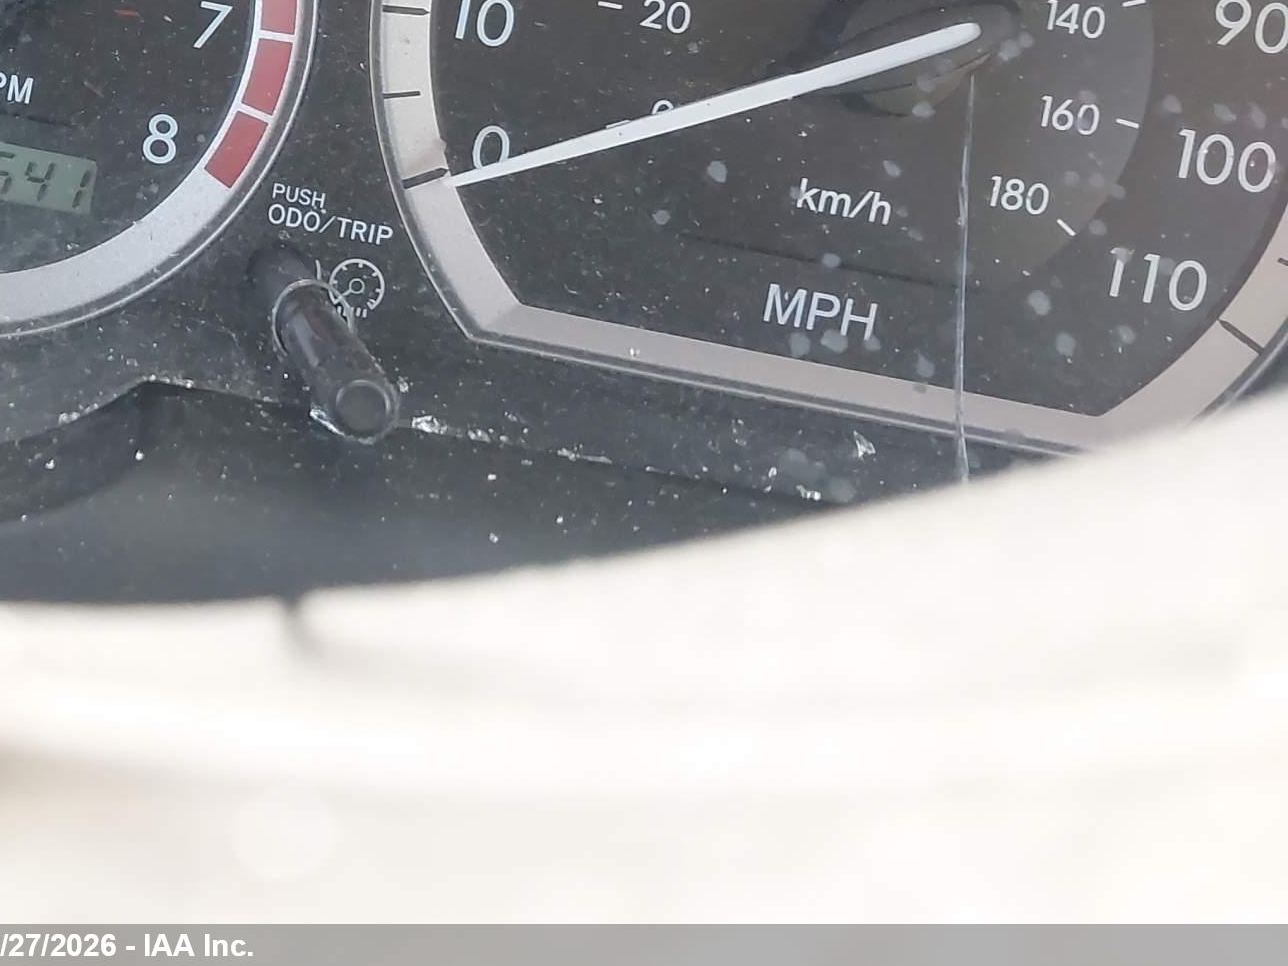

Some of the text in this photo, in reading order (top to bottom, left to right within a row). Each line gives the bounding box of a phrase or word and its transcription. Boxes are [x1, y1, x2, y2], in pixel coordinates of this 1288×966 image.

[193, 0, 232, 48] 7
[1046, 0, 1105, 39] 140
[141, 113, 179, 163] 8
[1041, 95, 1100, 135] 160
[472, 125, 510, 170] 0
[1177, 129, 1277, 193] 100
[272, 183, 326, 208] PUSH
[796, 177, 891, 225] km/h
[989, 176, 1049, 214] 180
[268, 204, 393, 245] ODO/TRIP
[1109, 247, 1207, 311] 110
[763, 283, 878, 341] MPH
